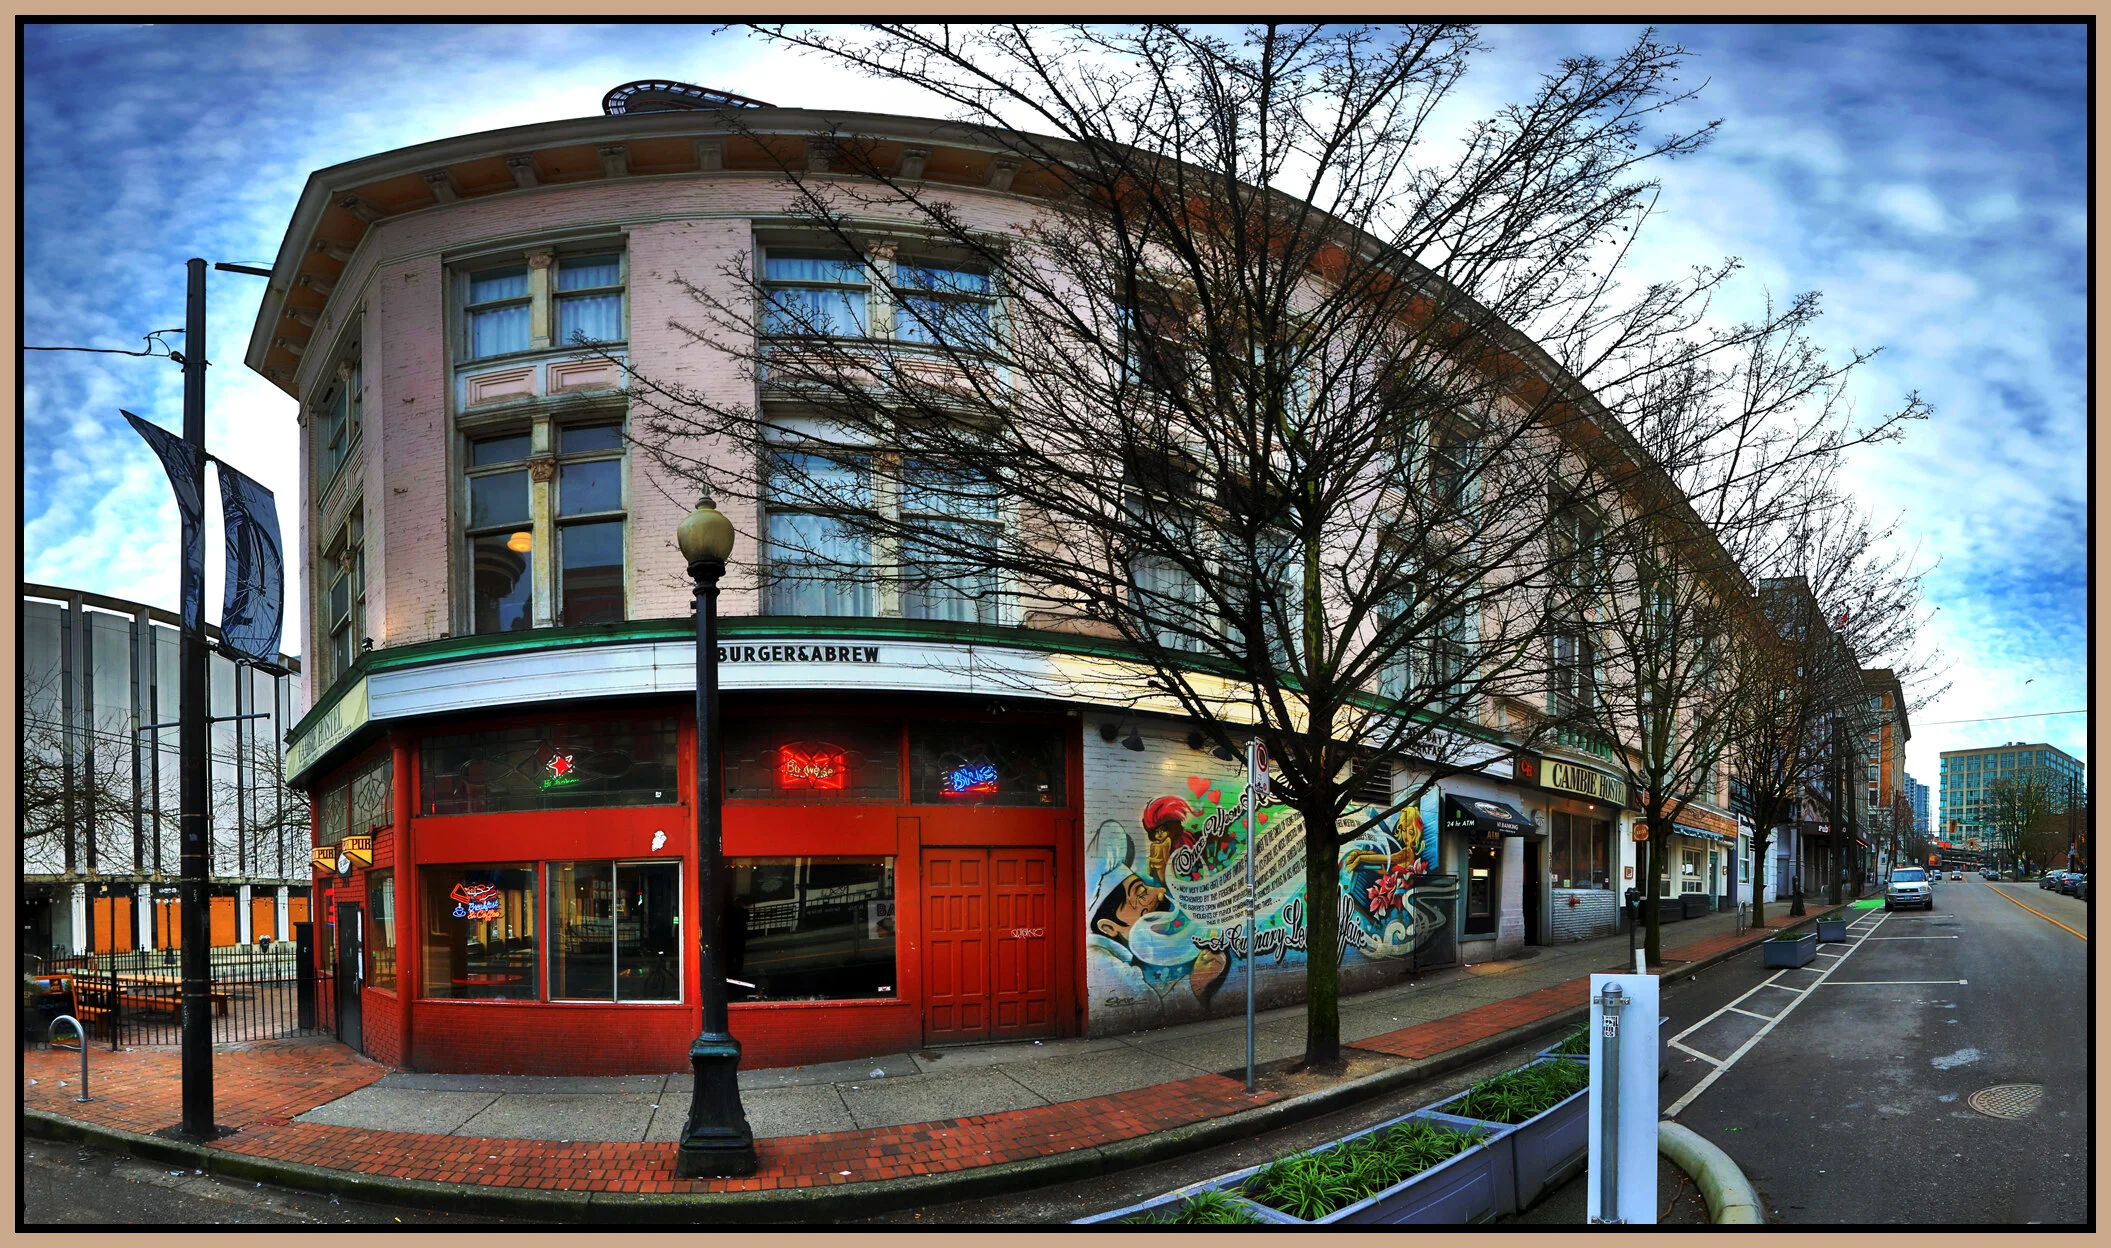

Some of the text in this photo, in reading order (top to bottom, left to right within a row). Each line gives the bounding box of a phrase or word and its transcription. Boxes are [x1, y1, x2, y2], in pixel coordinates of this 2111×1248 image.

[1553, 763, 1625, 804] CAMBIE HOSTEL
[1446, 820, 1454, 828] 24
[1461, 819, 1475, 827] ATM
[352, 838, 371, 850] PUB
[317, 849, 334, 859] PUB
[1172, 838, 1206, 874] Once
